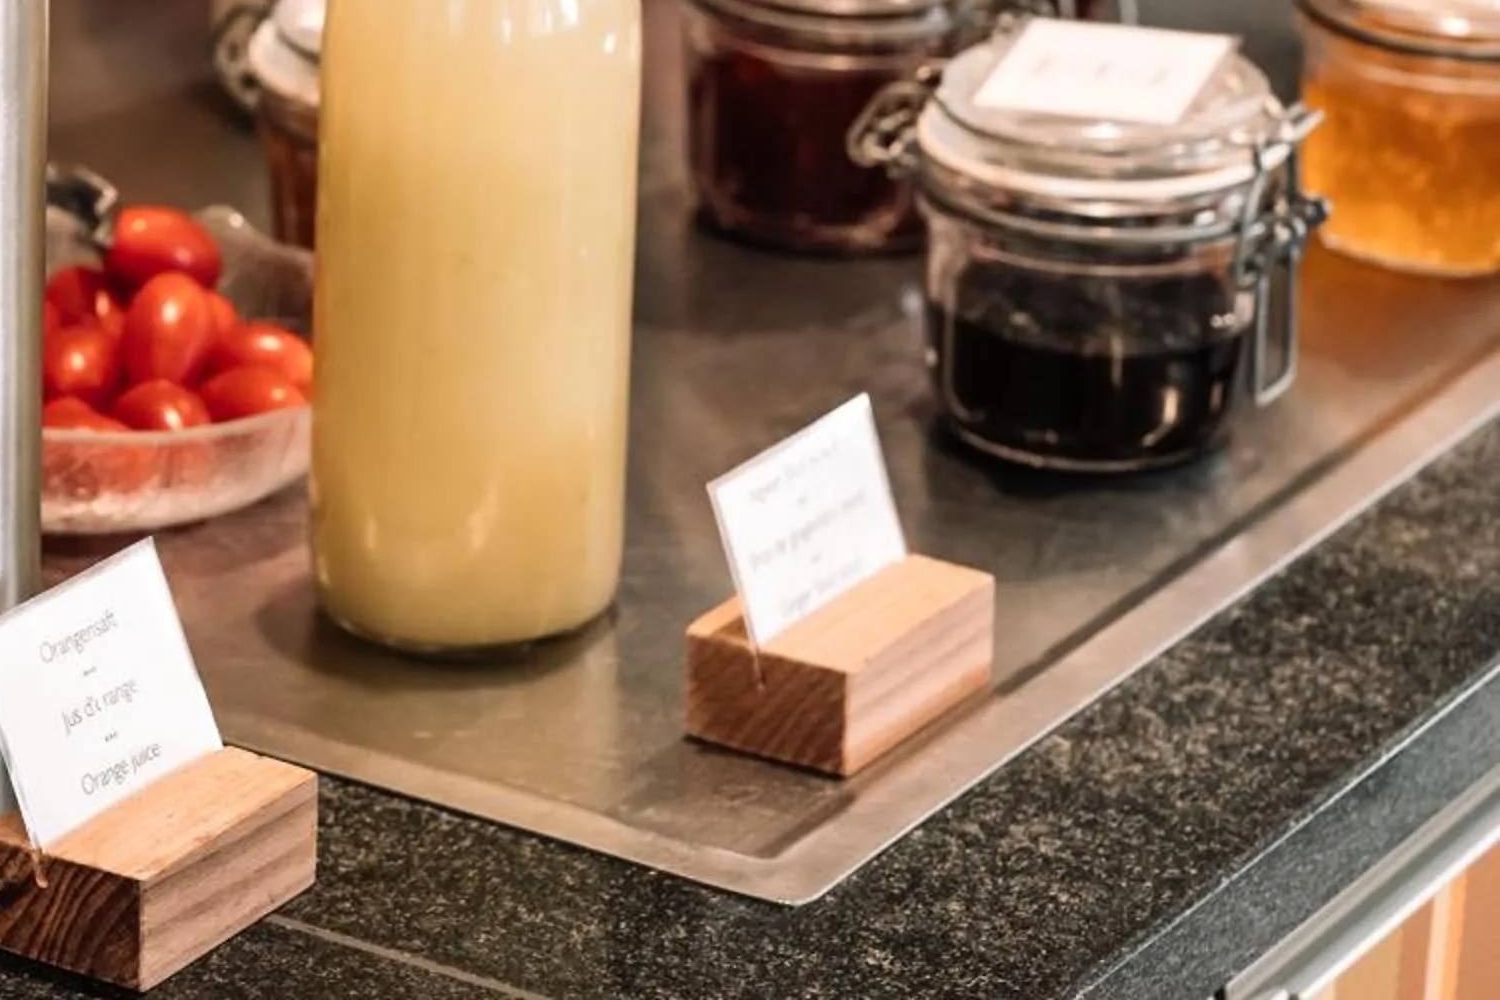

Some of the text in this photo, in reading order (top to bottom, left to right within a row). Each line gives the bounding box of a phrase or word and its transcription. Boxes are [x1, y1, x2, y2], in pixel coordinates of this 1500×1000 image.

[40, 608, 117, 663] Orangensaft
[62, 708, 83, 737] Jus
[81, 744, 161, 796] Orange juice
